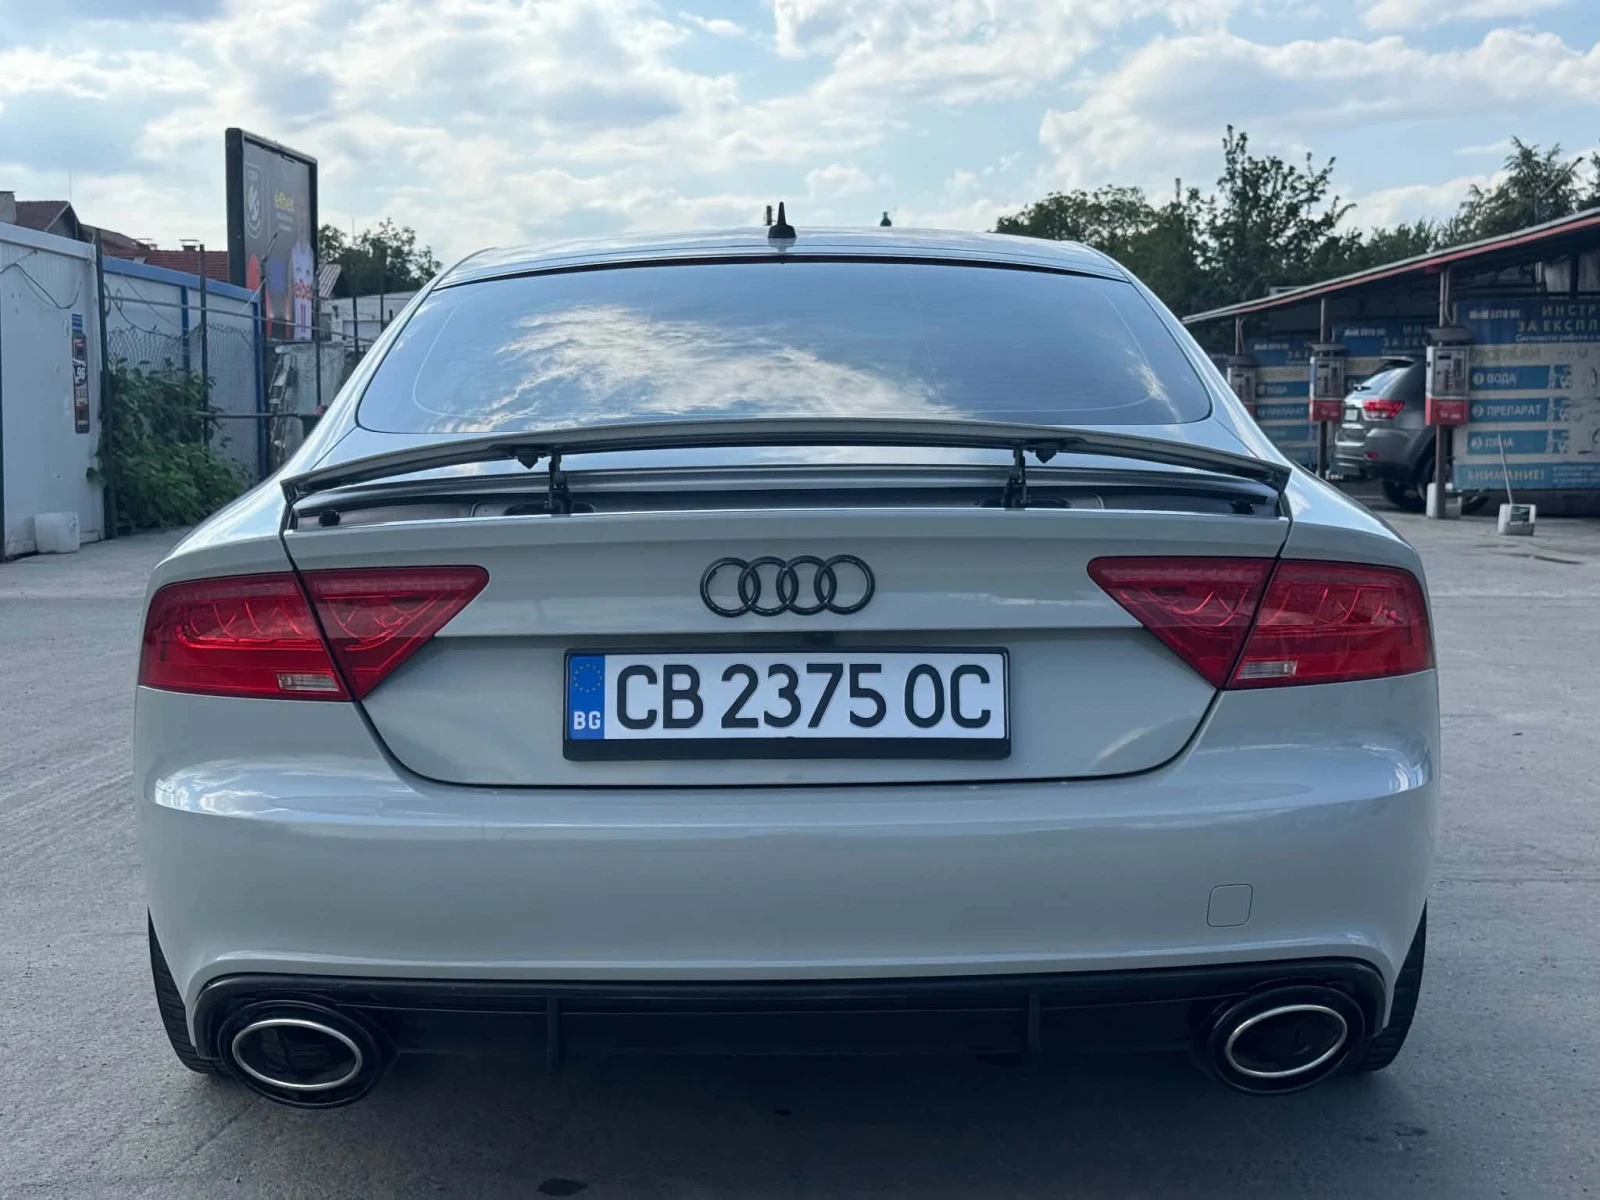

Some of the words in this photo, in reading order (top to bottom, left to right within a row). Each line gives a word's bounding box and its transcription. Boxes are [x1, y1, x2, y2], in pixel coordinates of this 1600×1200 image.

[1542, 304, 1600, 317] ИНСТР
[1517, 320, 1537, 332] ЗА
[1486, 373, 1517, 385] ВОДА
[1486, 404, 1541, 417] ПРЕПАРАТ
[617, 664, 704, 730] CB
[721, 663, 887, 729] 2375
[573, 711, 601, 730] BG
